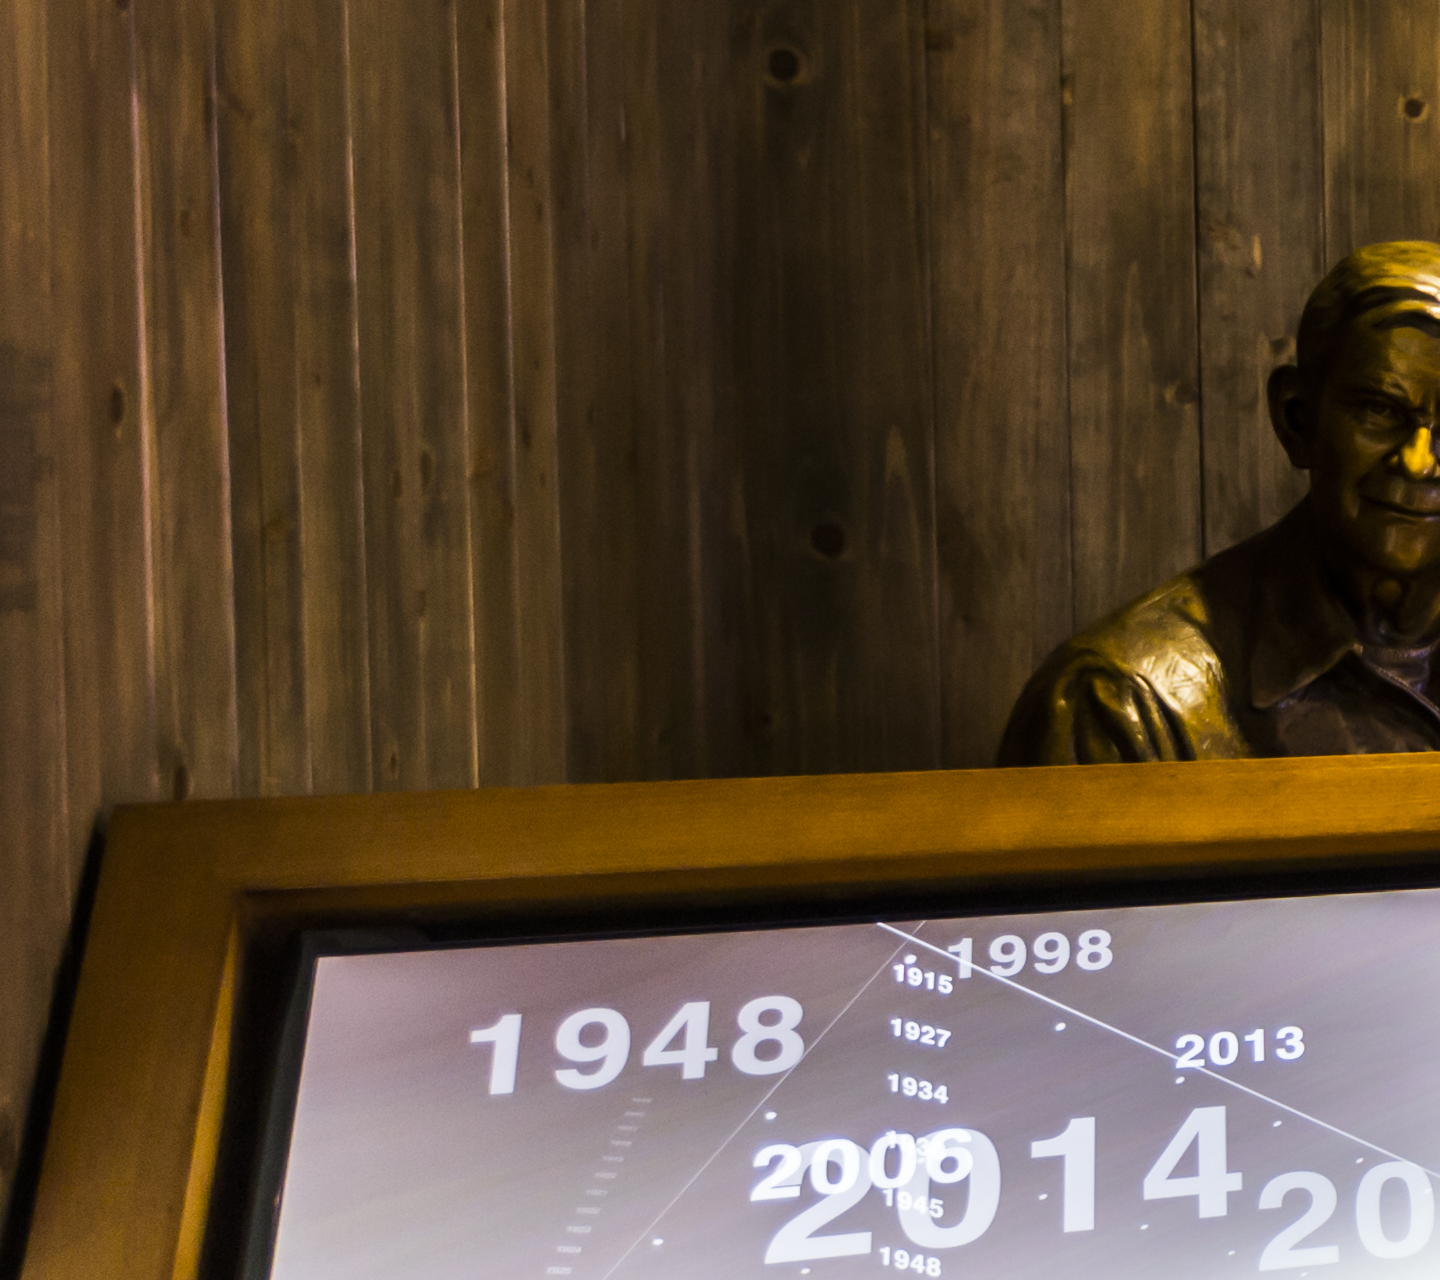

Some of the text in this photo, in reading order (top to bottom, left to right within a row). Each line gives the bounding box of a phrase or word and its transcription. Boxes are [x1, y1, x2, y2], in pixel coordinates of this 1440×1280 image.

[948, 928, 1114, 979] 1998
[893, 963, 954, 995] 1915
[468, 995, 806, 1096] 1948
[890, 1018, 951, 1048] 1927
[1175, 1025, 1306, 1069] 2013
[888, 1073, 949, 1104] 1934
[750, 1128, 974, 1201] 2006
[765, 1105, 1243, 1263] 2014
[883, 1188, 944, 1219] 1945
[879, 1246, 942, 1278] 1948
